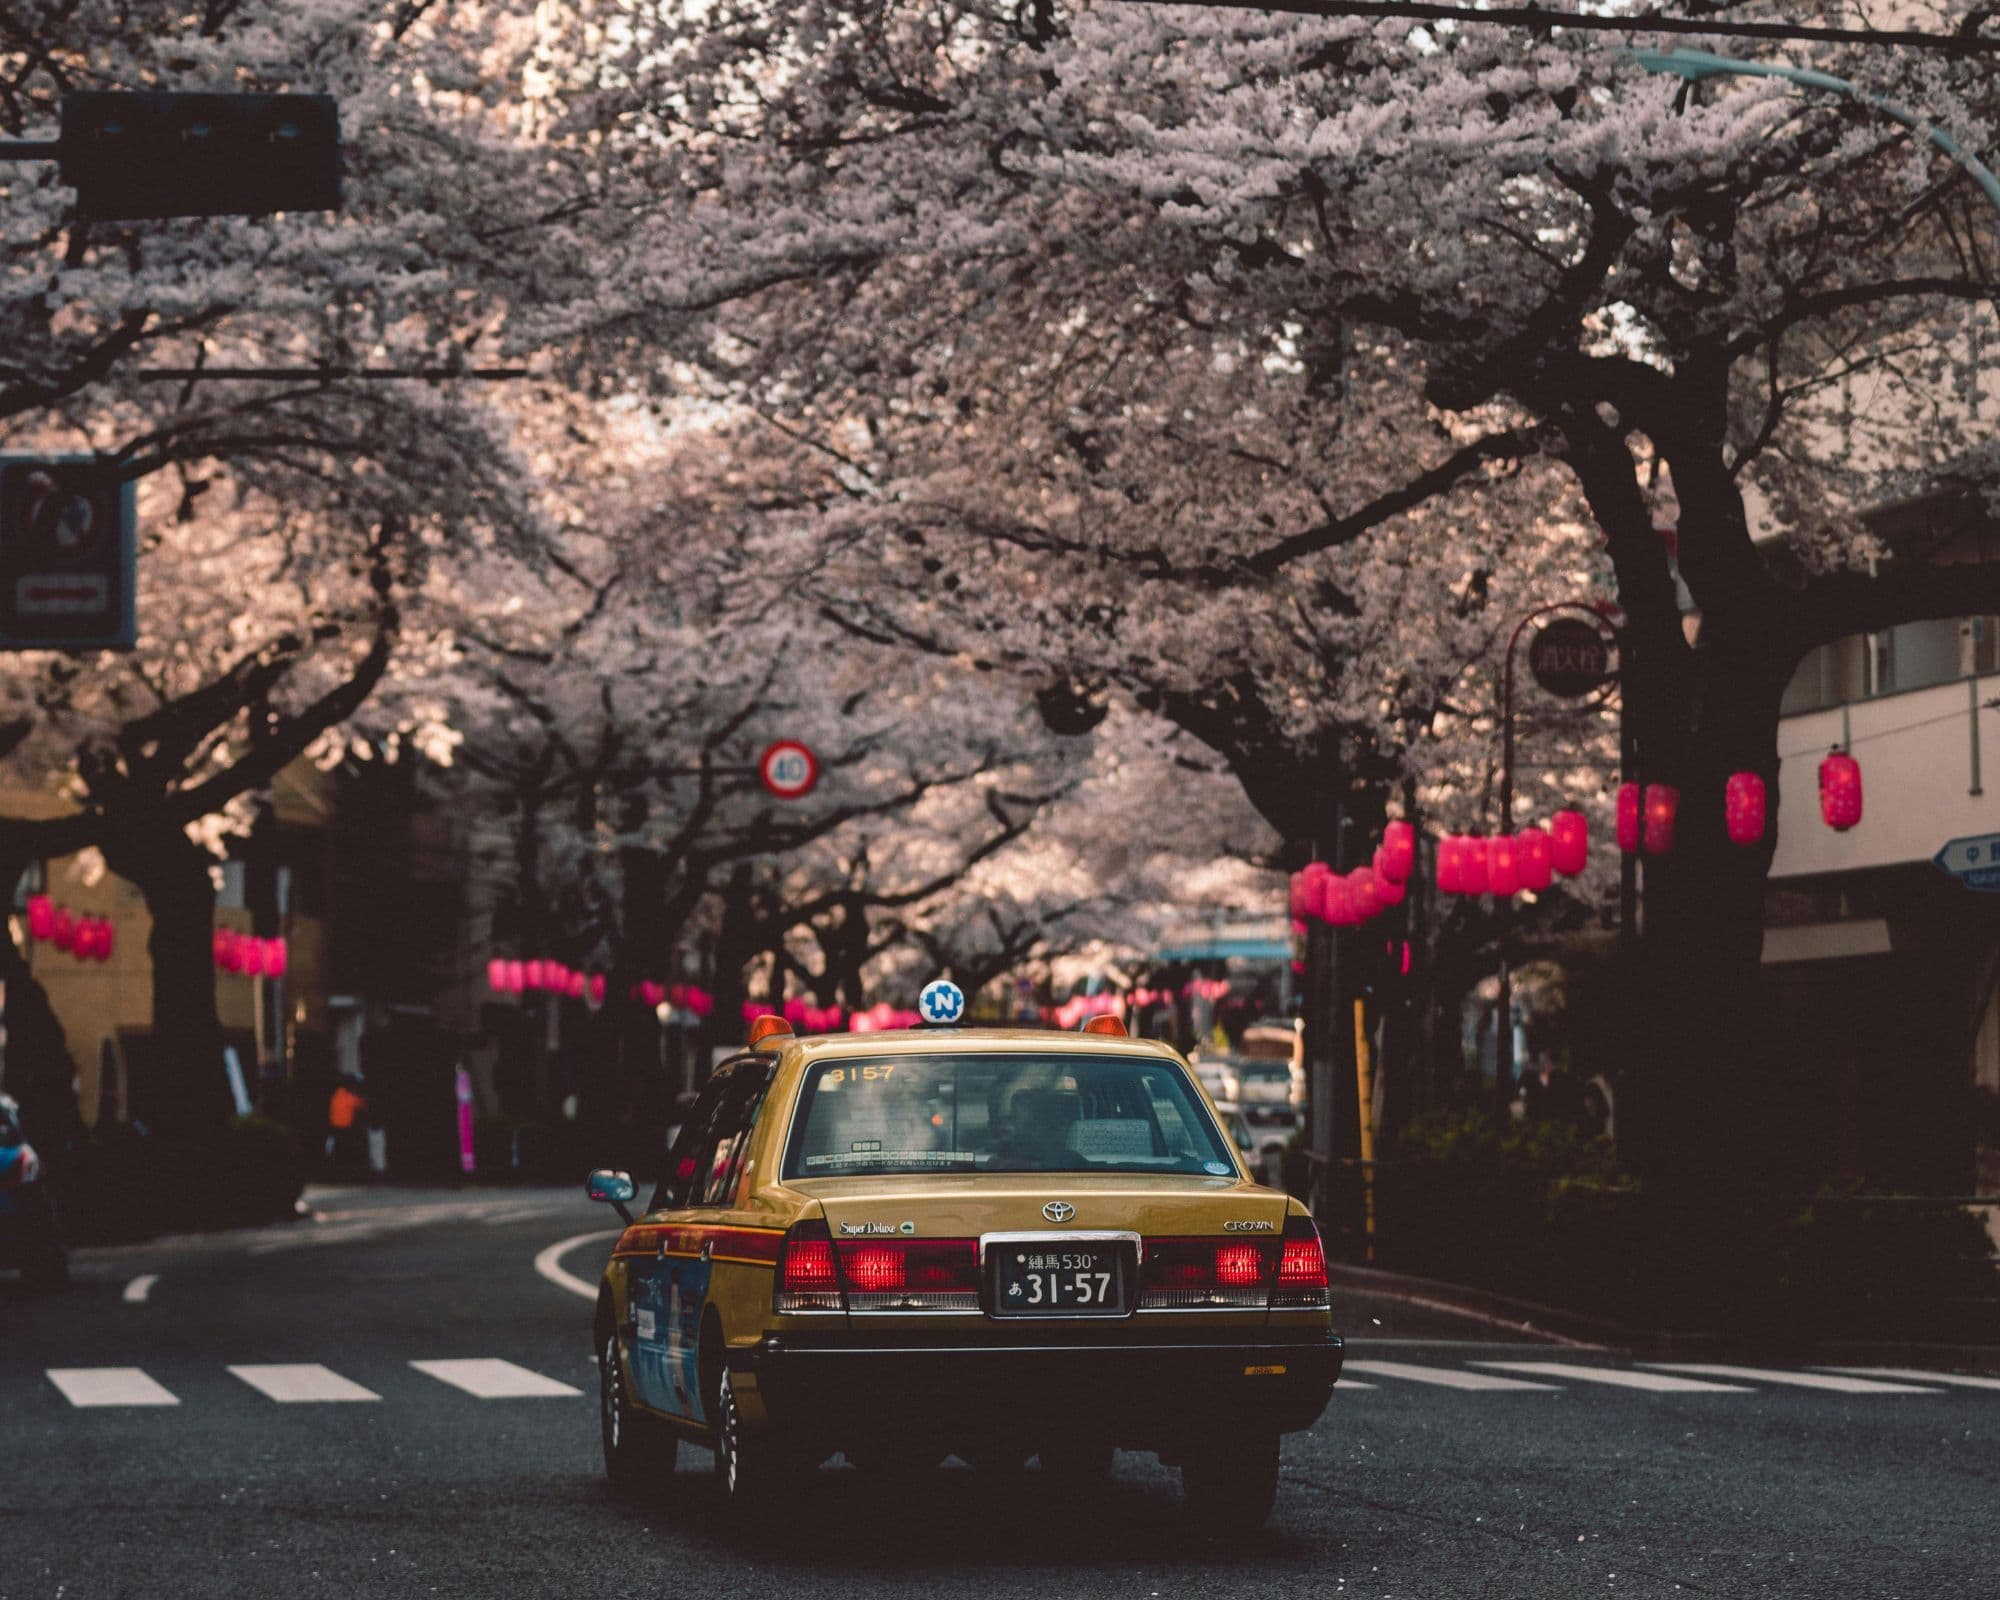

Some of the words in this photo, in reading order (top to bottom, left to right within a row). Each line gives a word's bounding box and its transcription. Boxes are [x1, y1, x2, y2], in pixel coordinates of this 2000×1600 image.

[773, 757, 807, 782] 40
[935, 992, 954, 1011] N
[830, 1064, 894, 1083] 3157
[839, 1220, 865, 1236] Super
[865, 1221, 897, 1234] Deluxe
[1223, 1220, 1274, 1231] CROWN
[1028, 1254, 1060, 1270] 練馬
[1062, 1254, 1092, 1270] 530
[1008, 1281, 1022, 1296] あ
[1026, 1272, 1111, 1304] 31-57
